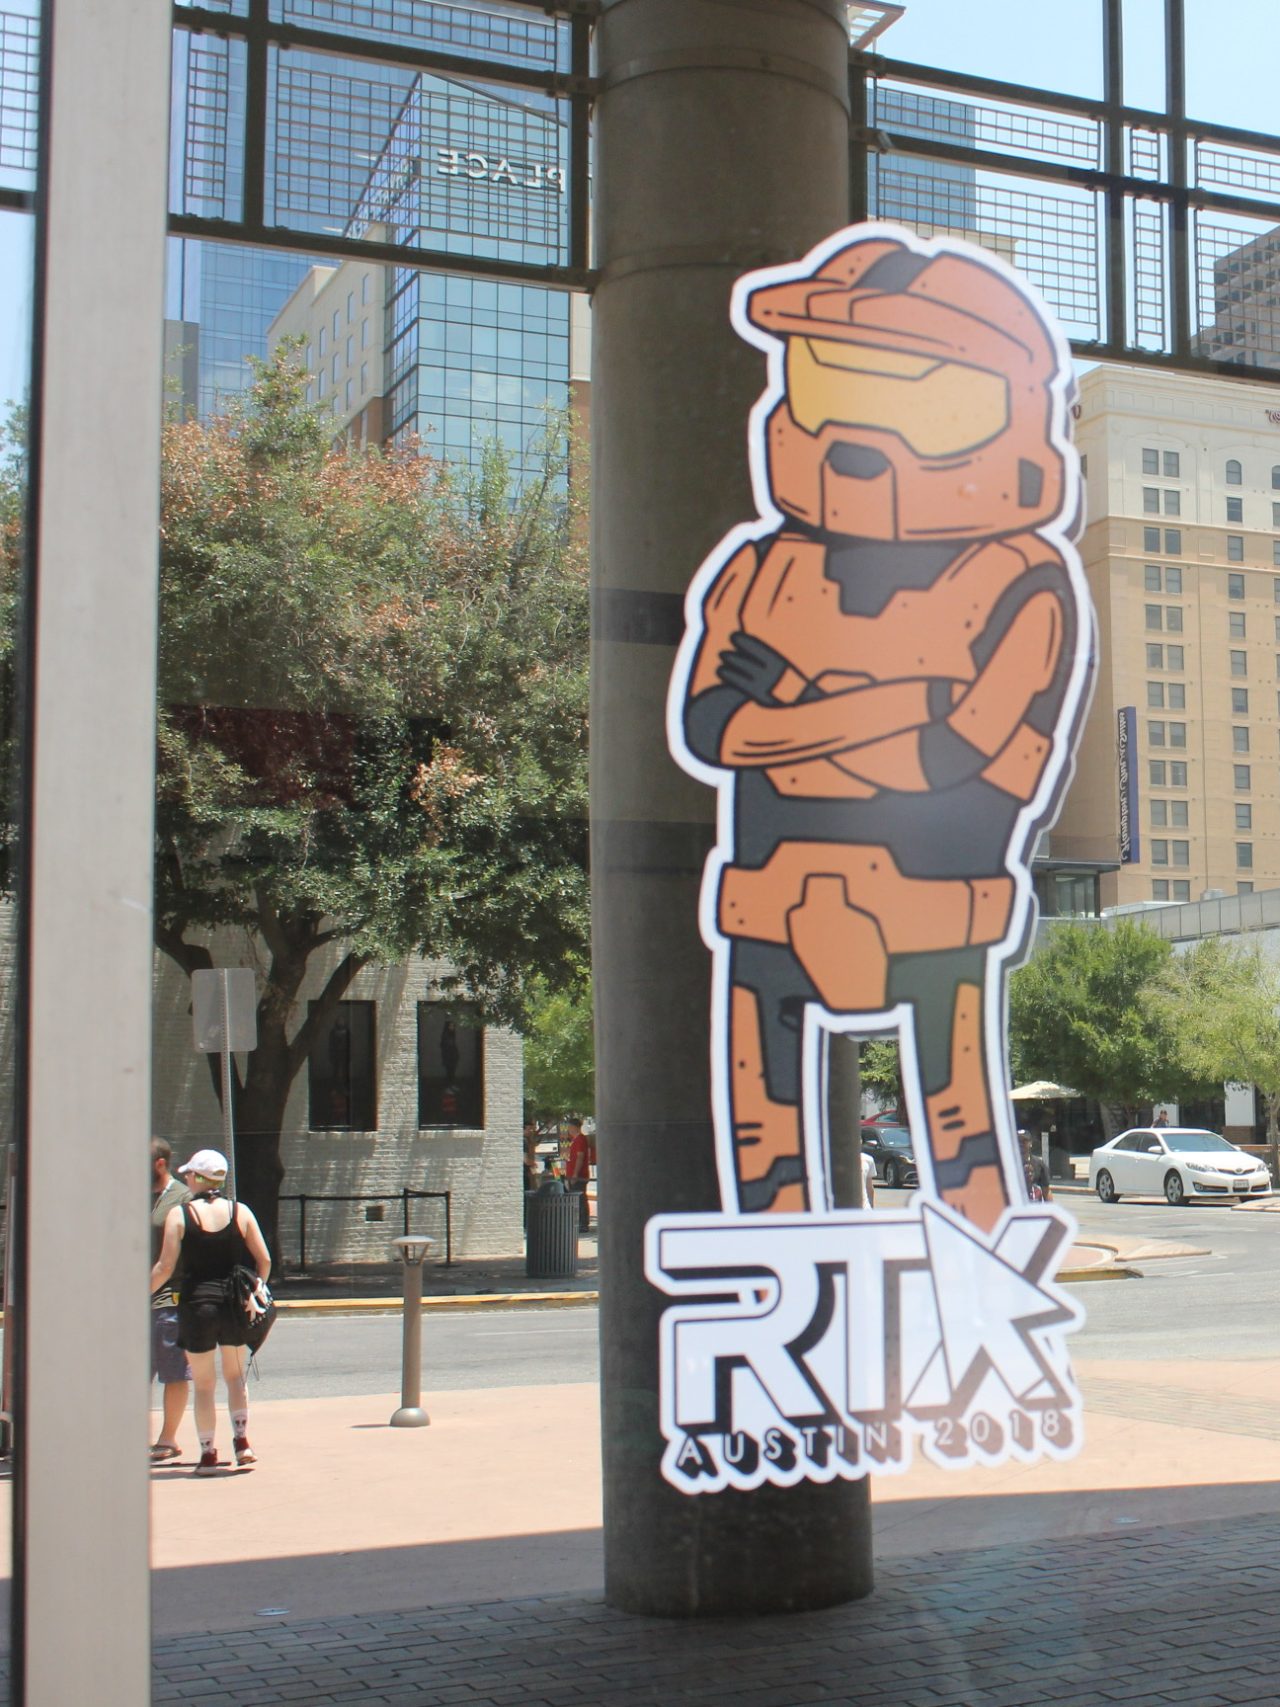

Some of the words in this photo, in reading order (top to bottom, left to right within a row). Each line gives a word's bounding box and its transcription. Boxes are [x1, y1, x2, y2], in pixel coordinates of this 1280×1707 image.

[658, 1202, 1076, 1432] RTX
[676, 1420, 896, 1474] AUSTIN
[933, 1408, 1068, 1452] 2018
